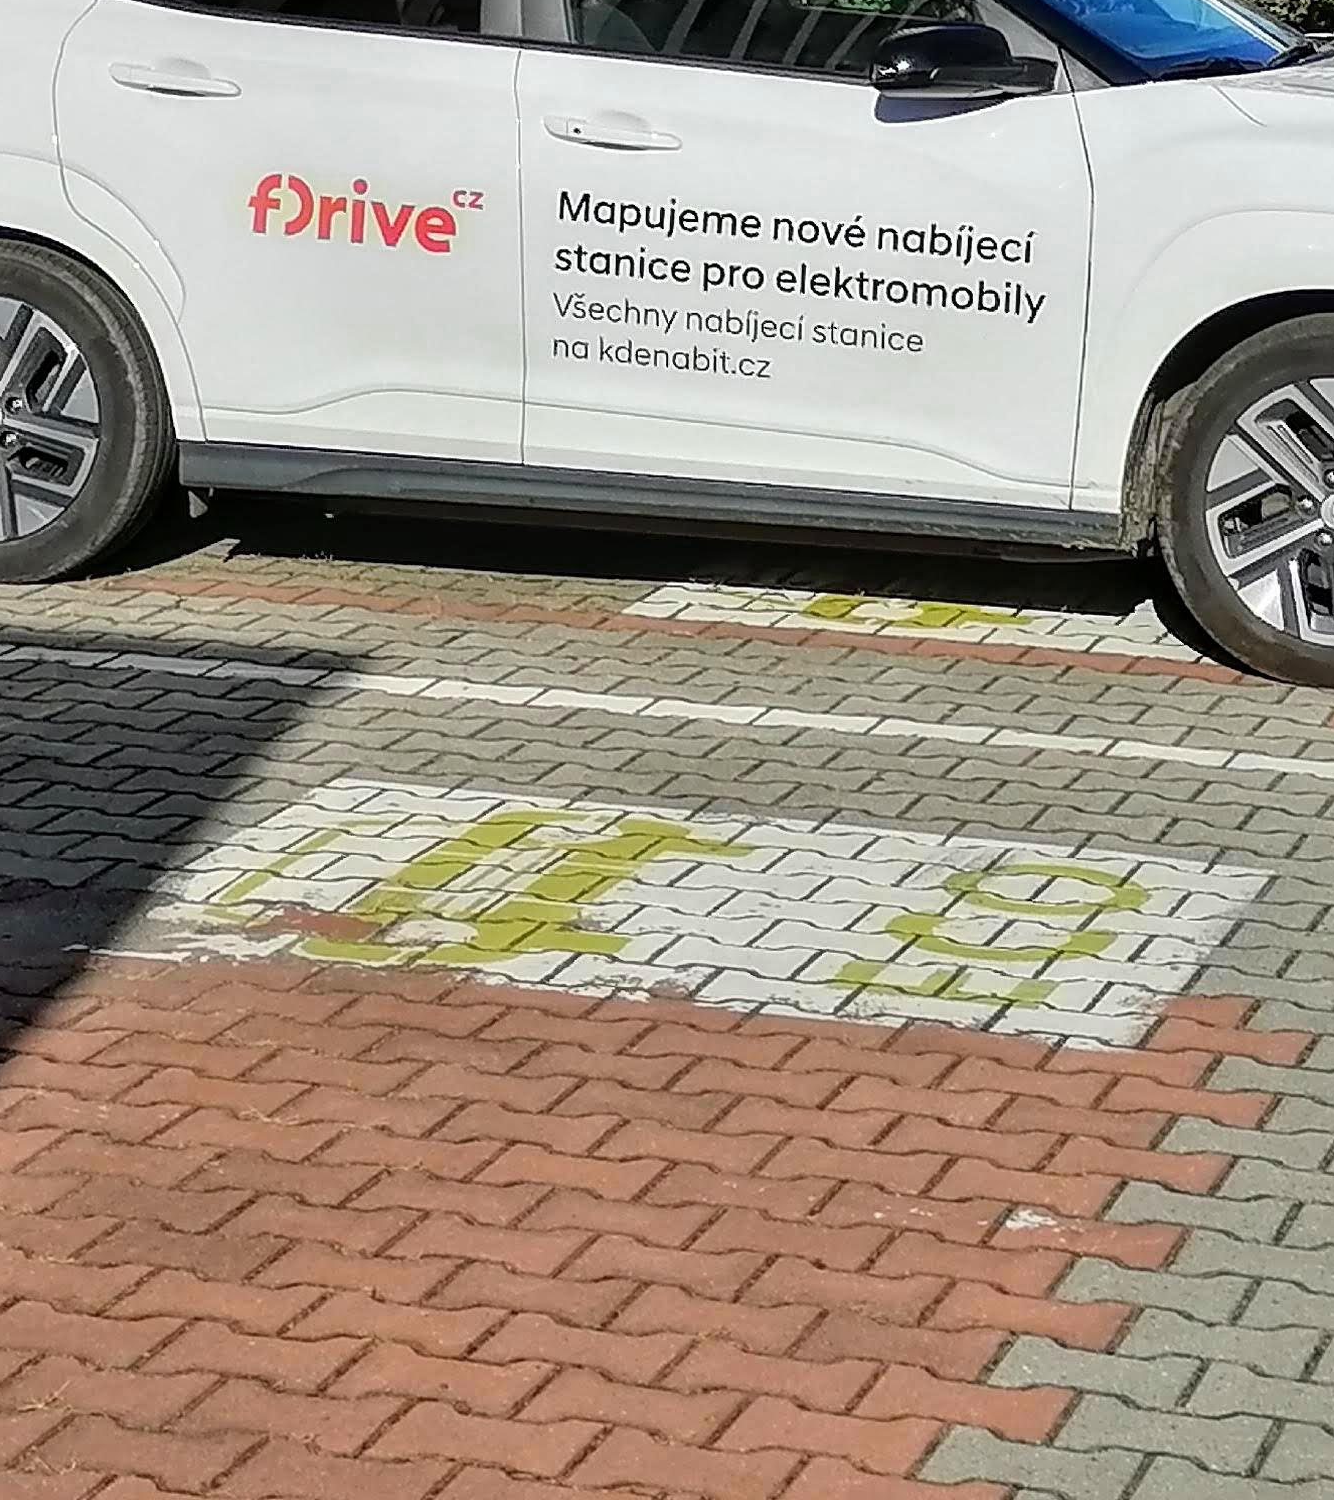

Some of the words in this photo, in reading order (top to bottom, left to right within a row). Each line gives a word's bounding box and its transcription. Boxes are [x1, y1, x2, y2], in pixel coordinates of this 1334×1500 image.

[559, 190, 761, 238] Mapujeme
[772, 214, 865, 249] nové
[877, 223, 1036, 266] nabíjecí
[555, 245, 691, 283] stanice
[703, 262, 765, 292] pro
[776, 263, 1046, 324] elektromobily
[553, 292, 677, 334] Všechny
[686, 308, 804, 343] nabíjecí
[812, 321, 923, 352] stanice
[553, 339, 589, 359] na
[599, 336, 771, 378] kdenabit.cz
